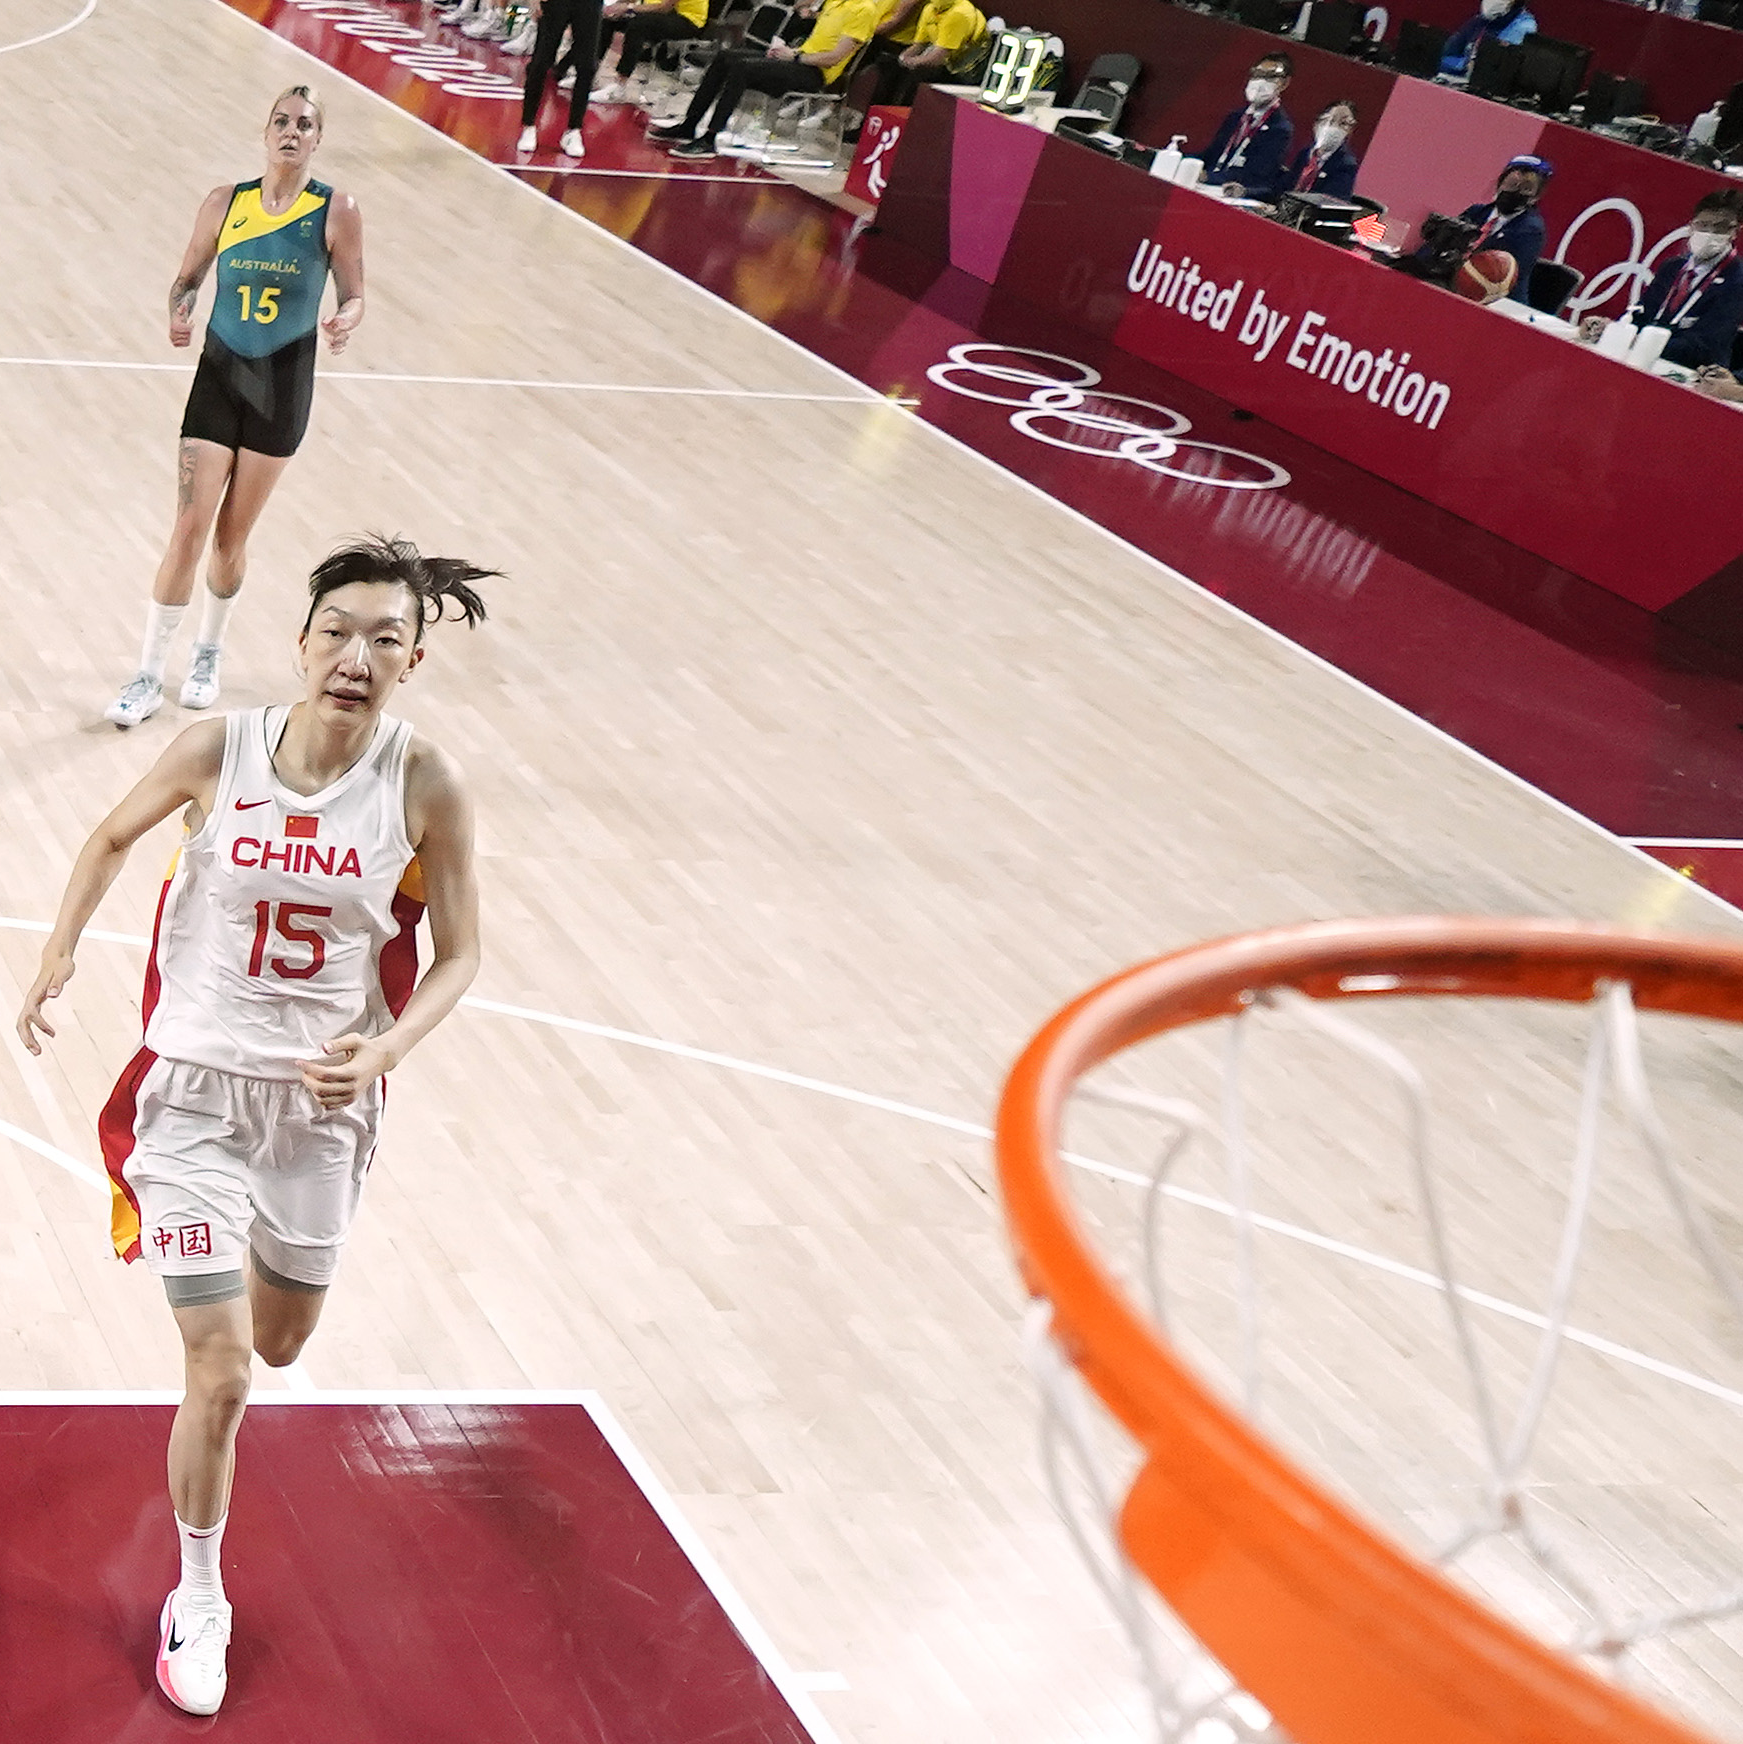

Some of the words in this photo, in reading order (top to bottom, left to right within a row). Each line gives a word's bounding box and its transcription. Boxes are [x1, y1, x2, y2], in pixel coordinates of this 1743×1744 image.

[982, 34, 1044, 105] 33
[229, 258, 300, 274] AUSTRALIA
[236, 284, 282, 325] 15
[1126, 238, 1244, 332] United
[1237, 288, 1291, 363] by
[1285, 310, 1451, 430] Emotion
[230, 836, 363, 878] CHINA
[247, 899, 333, 980] 15
[151, 1222, 213, 1259] 中国
